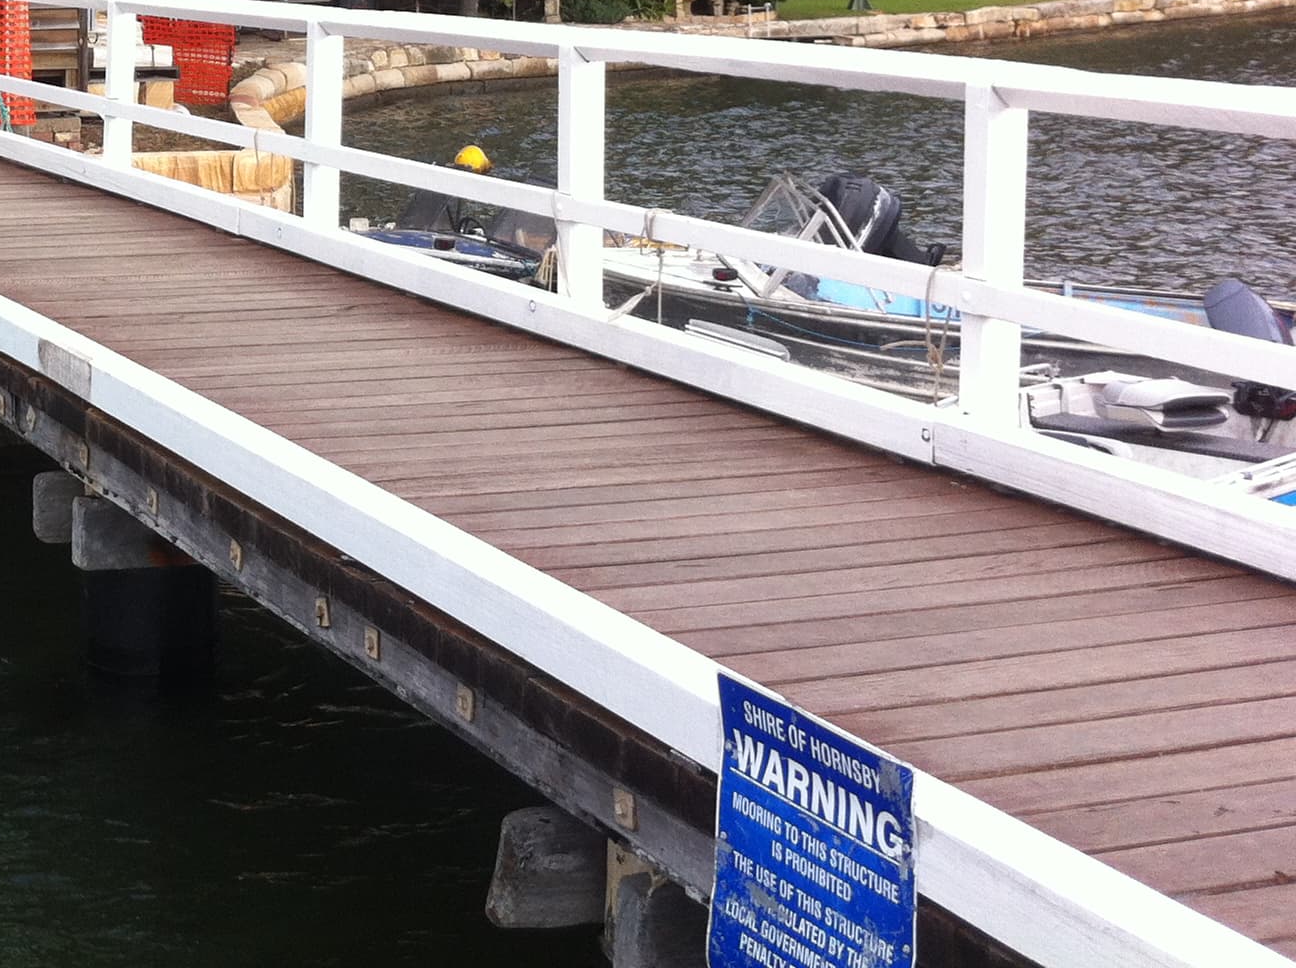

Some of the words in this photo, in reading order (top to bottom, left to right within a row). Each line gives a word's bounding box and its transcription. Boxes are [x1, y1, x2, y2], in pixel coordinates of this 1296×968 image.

[733, 728, 904, 858] WARNING
[743, 700, 786, 743] SHIRE
[788, 724, 807, 752] OF
[810, 735, 880, 794] HORNSBY
[732, 791, 782, 836] MOORING
[785, 821, 799, 845] TO
[801, 830, 827, 861] THIS
[829, 848, 900, 905] STRUCTURE
[771, 840, 783, 862] IS
[785, 848, 852, 902] PROHIBITED
[725, 899, 759, 933] LOCAL
[732, 850, 754, 875] THE
[756, 864, 778, 892] USE
[779, 878, 795, 902] OF
[797, 888, 822, 919] THIS
[824, 905, 895, 964] STRUCTURE
[829, 935, 844, 960] BY
